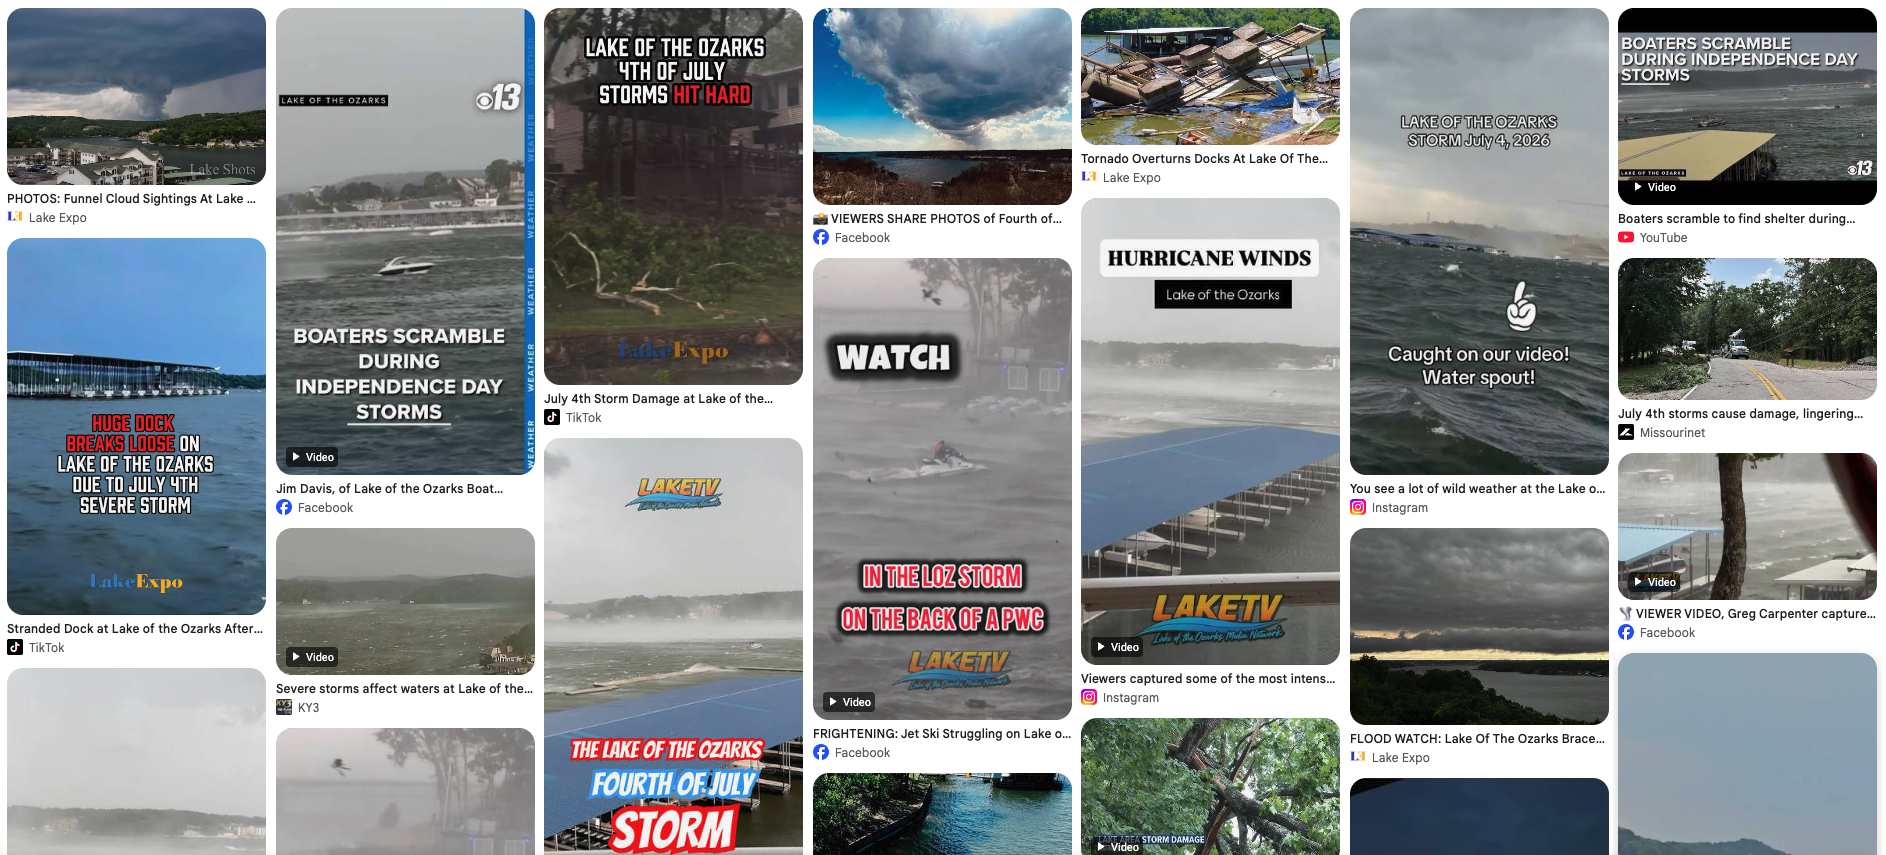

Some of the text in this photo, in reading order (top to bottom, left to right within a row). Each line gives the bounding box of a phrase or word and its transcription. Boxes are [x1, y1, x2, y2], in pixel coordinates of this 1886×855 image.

[1081, 153, 1128, 163] Tornado
[1132, 154, 1190, 163] Overturns
[1195, 153, 1229, 163] Docks
[1233, 154, 1245, 163] At
[1250, 153, 1276, 163] Lake
[1280, 153, 1294, 163] Of
[1104, 173, 1160, 185] Lake Expo
[8, 193, 243, 206] PHOTOS: Funnel Cloud Sightings At Lake
[30, 213, 86, 225] Lake Expo
[1619, 214, 1663, 223] Boaters
[1667, 213, 1720, 223] scramble
[1724, 214, 1735, 223] to
[1739, 213, 1760, 223] find
[1765, 213, 1805, 223] shelter
[836, 232, 890, 242] Facebook
[1640, 233, 1687, 242] YouTube
[566, 412, 601, 422] TikTok
[1641, 427, 1705, 437] Missourinet
[299, 502, 353, 512] Facebook
[1373, 503, 1427, 515] Instagram
[1636, 609, 1681, 618] VIEWER
[1684, 609, 1724, 619] VIDEO,
[1728, 609, 1755, 621] Greg
[1759, 609, 1818, 621] Carpenter
[8, 623, 60, 633] Stranded
[65, 623, 93, 633] Dock
[97, 625, 108, 633] at
[113, 623, 139, 633] Lake
[143, 623, 154, 633] of
[159, 623, 177, 633] the
[181, 623, 221, 633] Ozarks
[29, 642, 64, 652] TikTok
[1104, 693, 1158, 705] Instagram
[299, 703, 319, 712] KY3
[1351, 734, 1391, 743] FLOOD
[1395, 734, 1441, 743] WATCH:
[1446, 733, 1472, 743] Lake
[1476, 733, 1489, 743] Of
[1493, 733, 1514, 743] The
[1518, 733, 1558, 743] Ozarks
